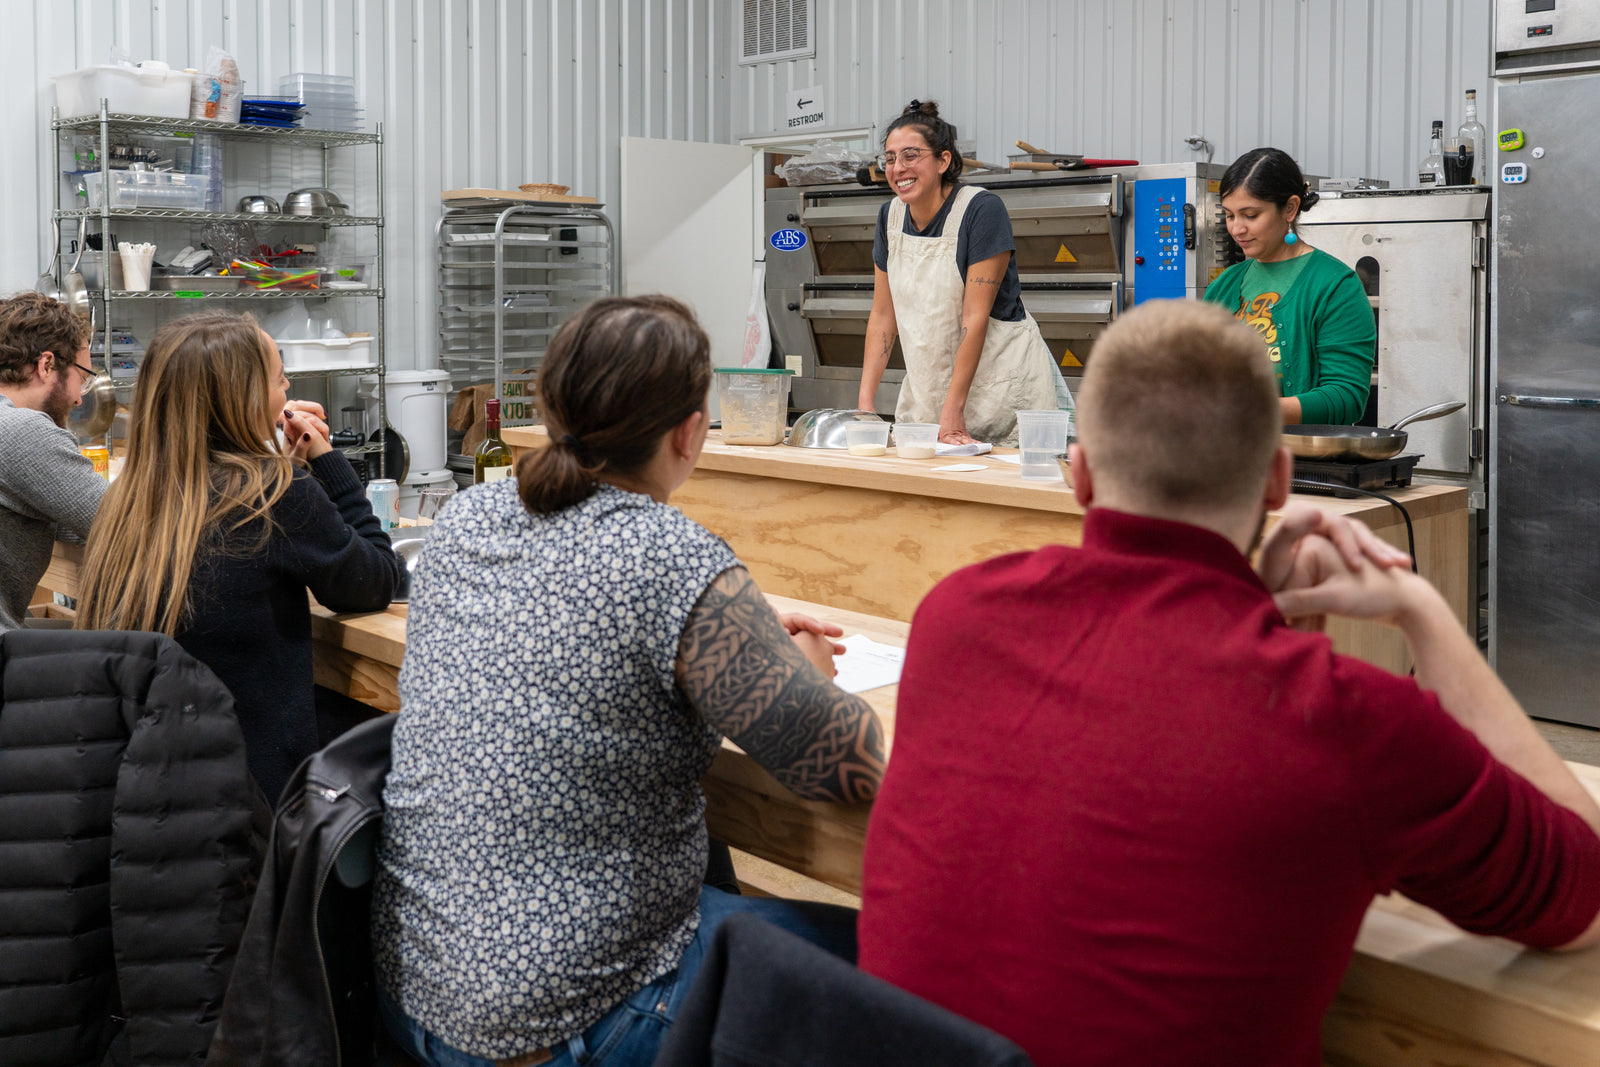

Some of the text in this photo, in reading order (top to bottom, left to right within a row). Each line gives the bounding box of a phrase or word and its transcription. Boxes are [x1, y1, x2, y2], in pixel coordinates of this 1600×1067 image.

[788, 112, 824, 128] RESTROOM
[775, 231, 800, 244] ABS
[502, 383, 523, 396] EALLY
[502, 401, 524, 419] NTO
